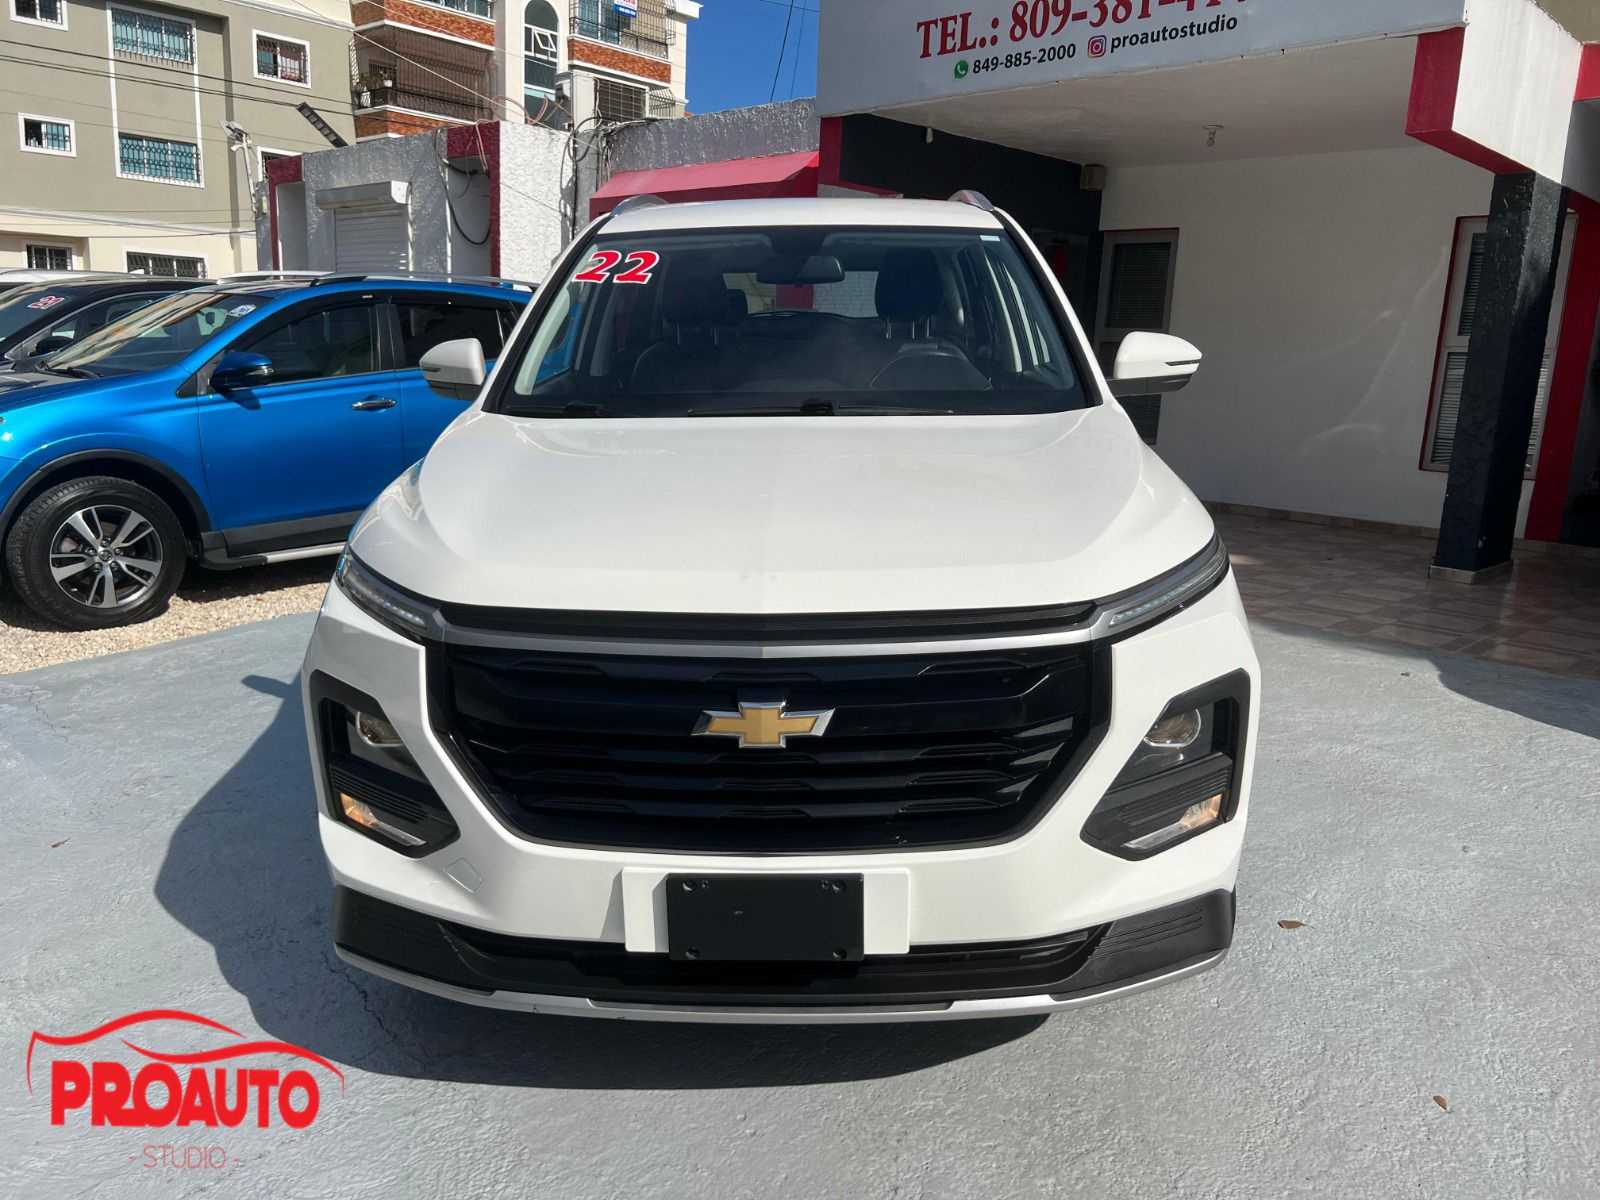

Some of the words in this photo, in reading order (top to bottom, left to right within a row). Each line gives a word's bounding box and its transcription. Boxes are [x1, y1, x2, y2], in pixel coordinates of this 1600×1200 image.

[916, 12, 1000, 59] TEL.:
[972, 43, 1076, 75] 849-885-2000
[1110, 14, 1238, 53] proautostudio
[571, 249, 660, 284] 22
